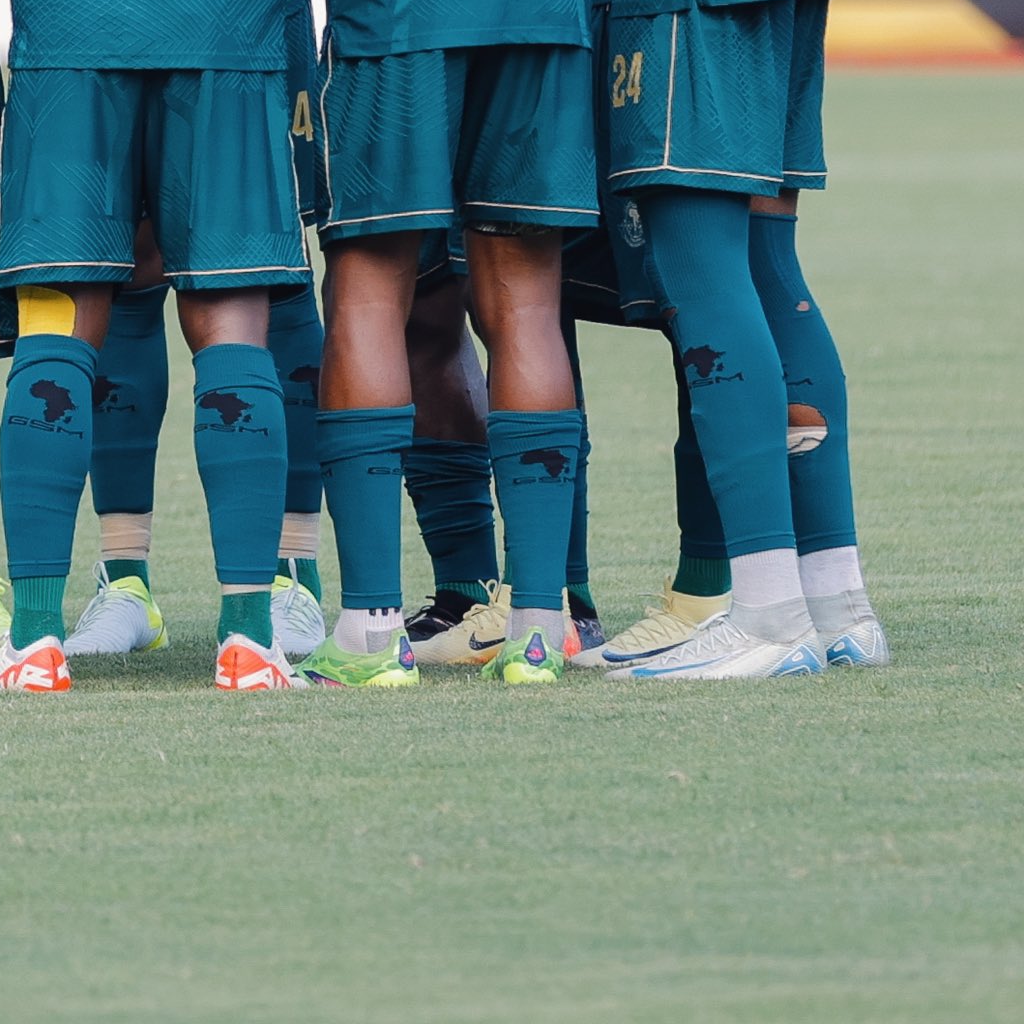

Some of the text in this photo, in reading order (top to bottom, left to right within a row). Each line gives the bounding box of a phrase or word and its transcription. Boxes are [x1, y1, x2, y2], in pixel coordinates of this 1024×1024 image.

[613, 51, 643, 108] 24
[8, 415, 83, 440] GSM
[195, 423, 269, 436] GSM
